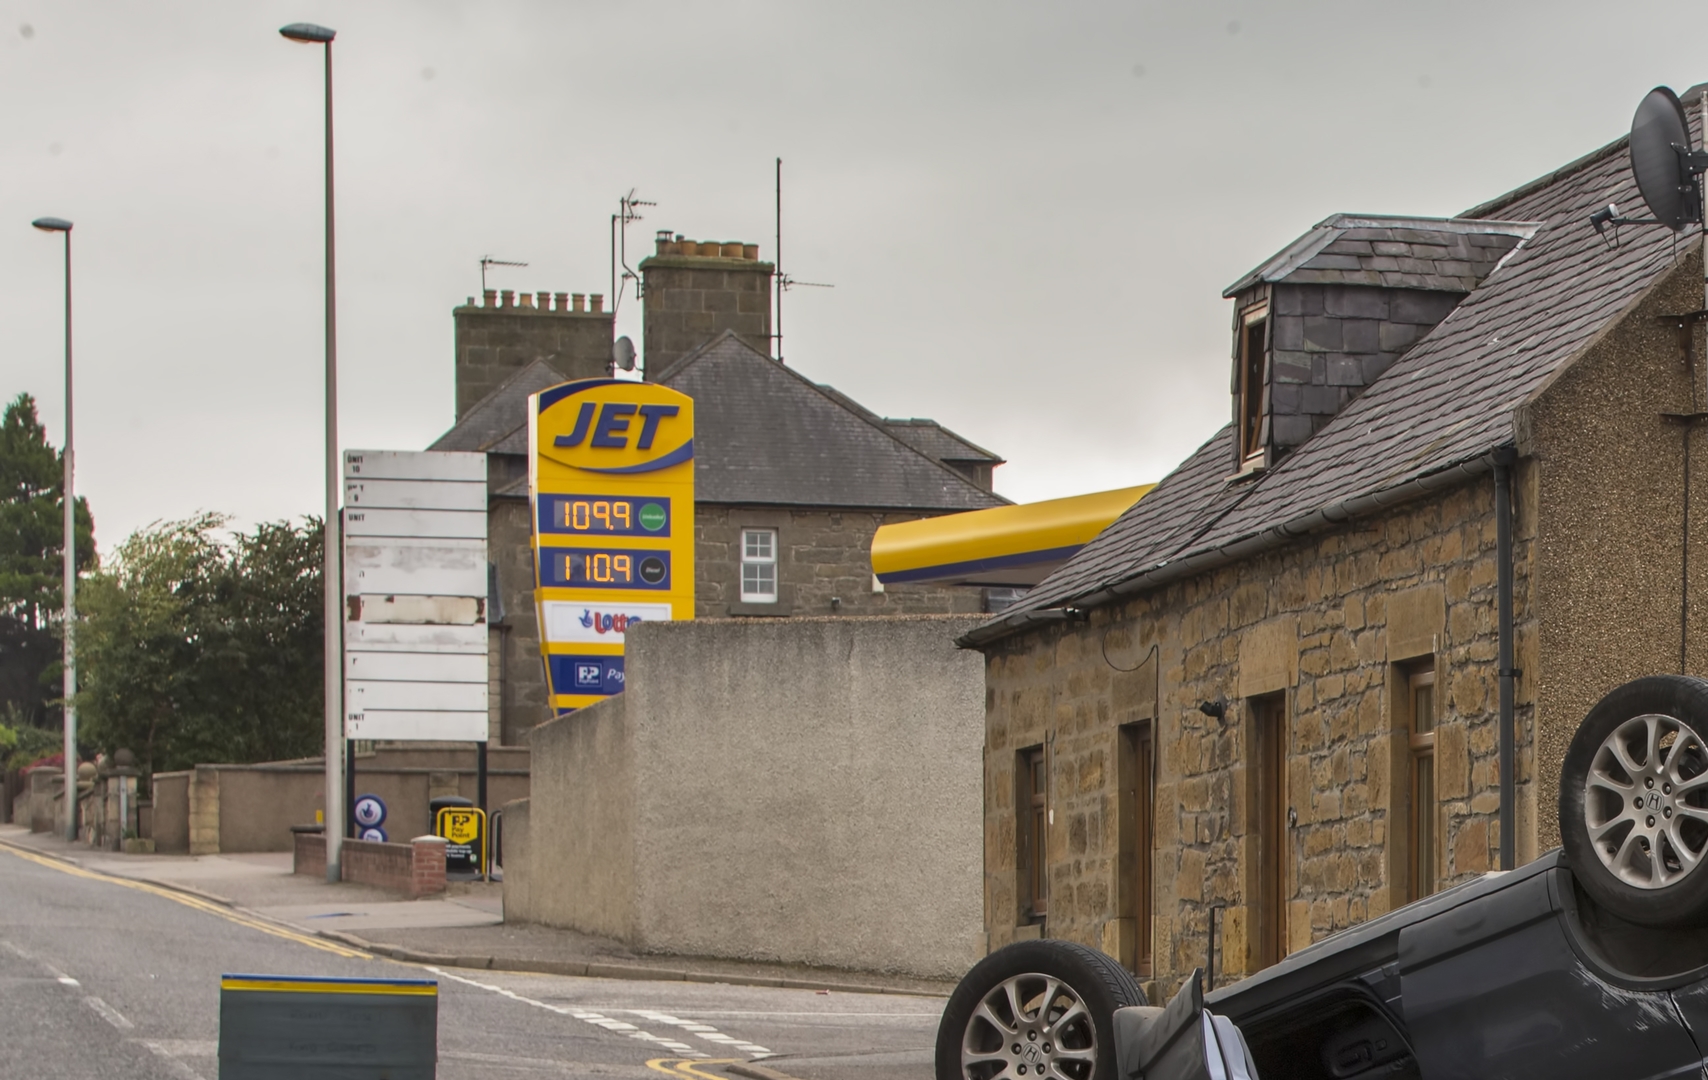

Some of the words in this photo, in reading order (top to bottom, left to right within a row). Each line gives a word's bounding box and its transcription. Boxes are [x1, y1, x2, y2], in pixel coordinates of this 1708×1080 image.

[553, 402, 680, 450] JET
[352, 465, 360, 473] 10
[348, 513, 365, 521] UNIT
[564, 501, 630, 530] 109.9
[565, 553, 631, 583] 110.9
[348, 713, 365, 721] UNIT
[355, 722, 359, 730] 1
